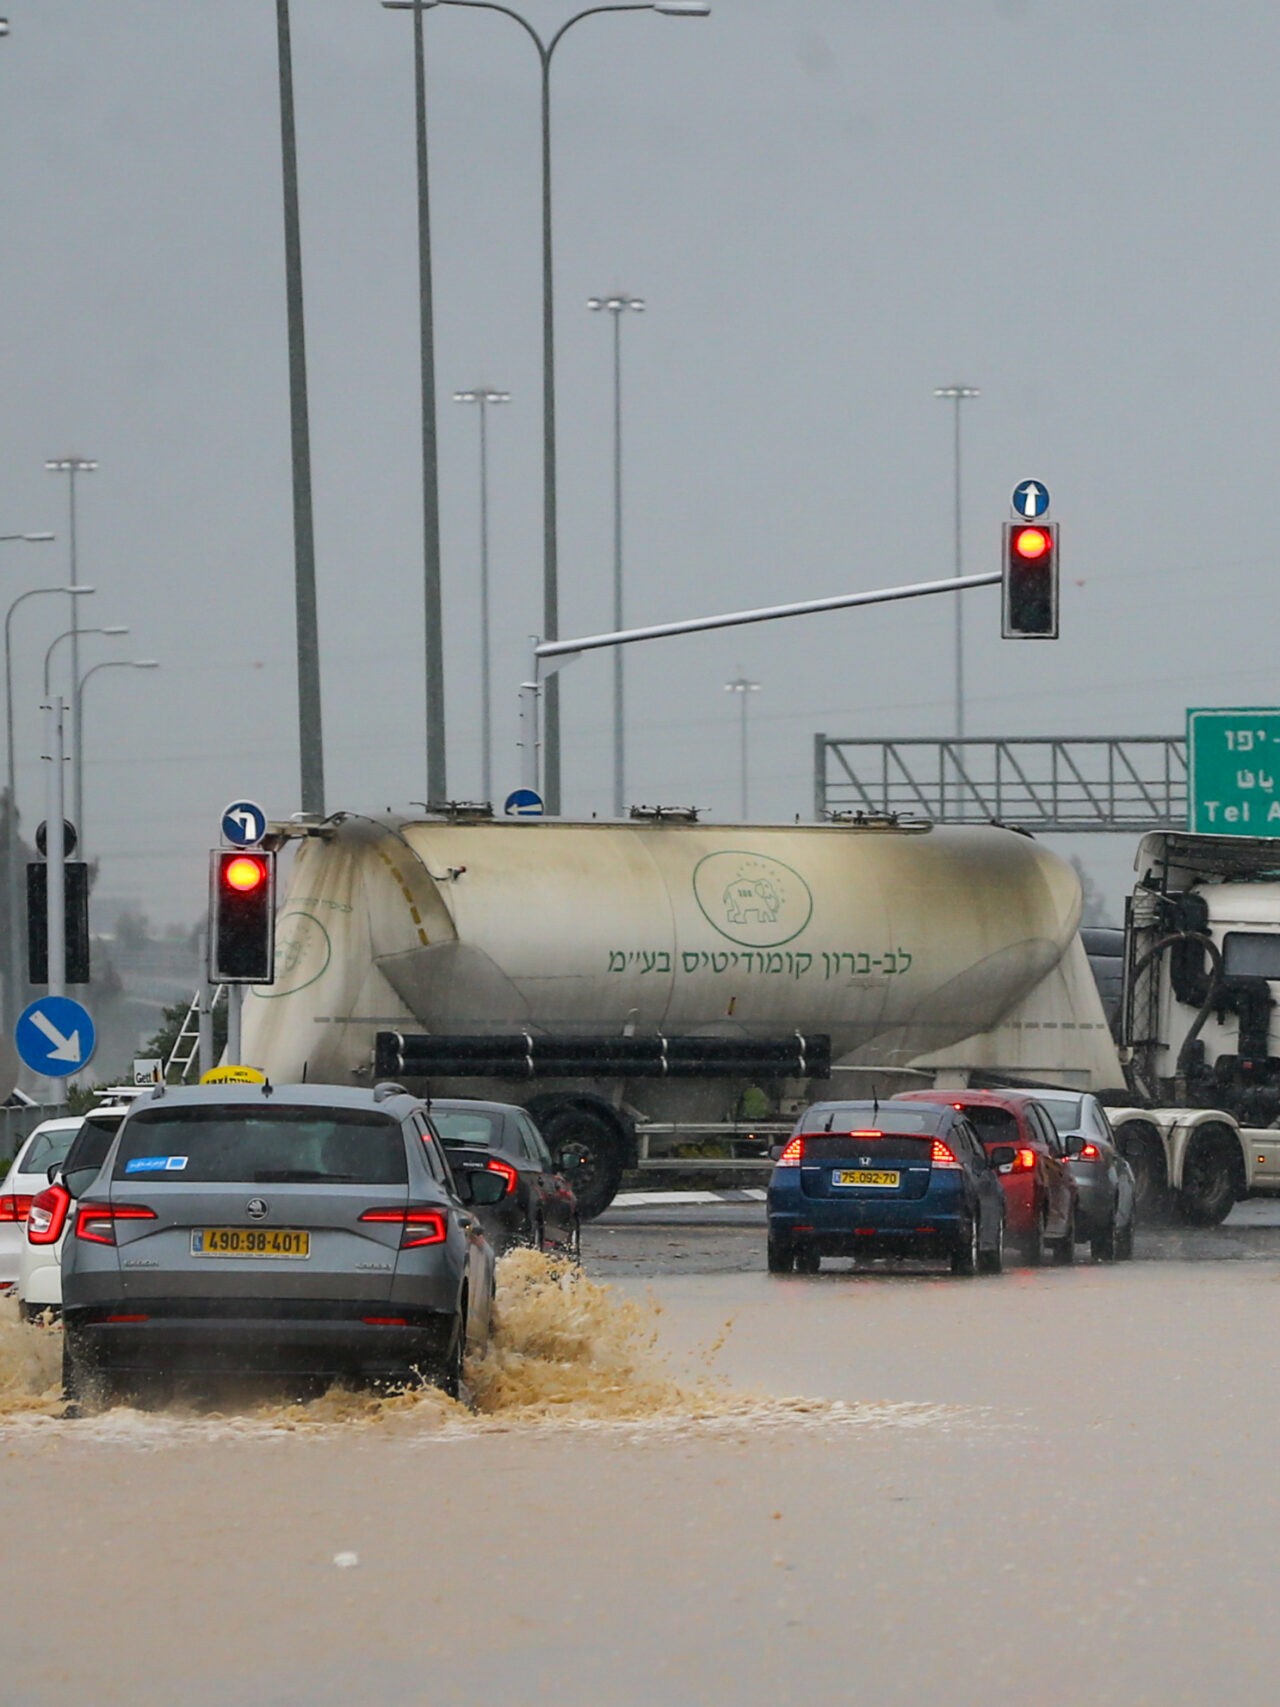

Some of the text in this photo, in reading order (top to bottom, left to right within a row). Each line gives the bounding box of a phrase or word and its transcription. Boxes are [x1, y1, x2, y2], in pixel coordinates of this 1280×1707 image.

[1203, 800, 1250, 822] Tel
[681, 950, 812, 979] קומודיטיס
[822, 947, 913, 979] לב-ברון
